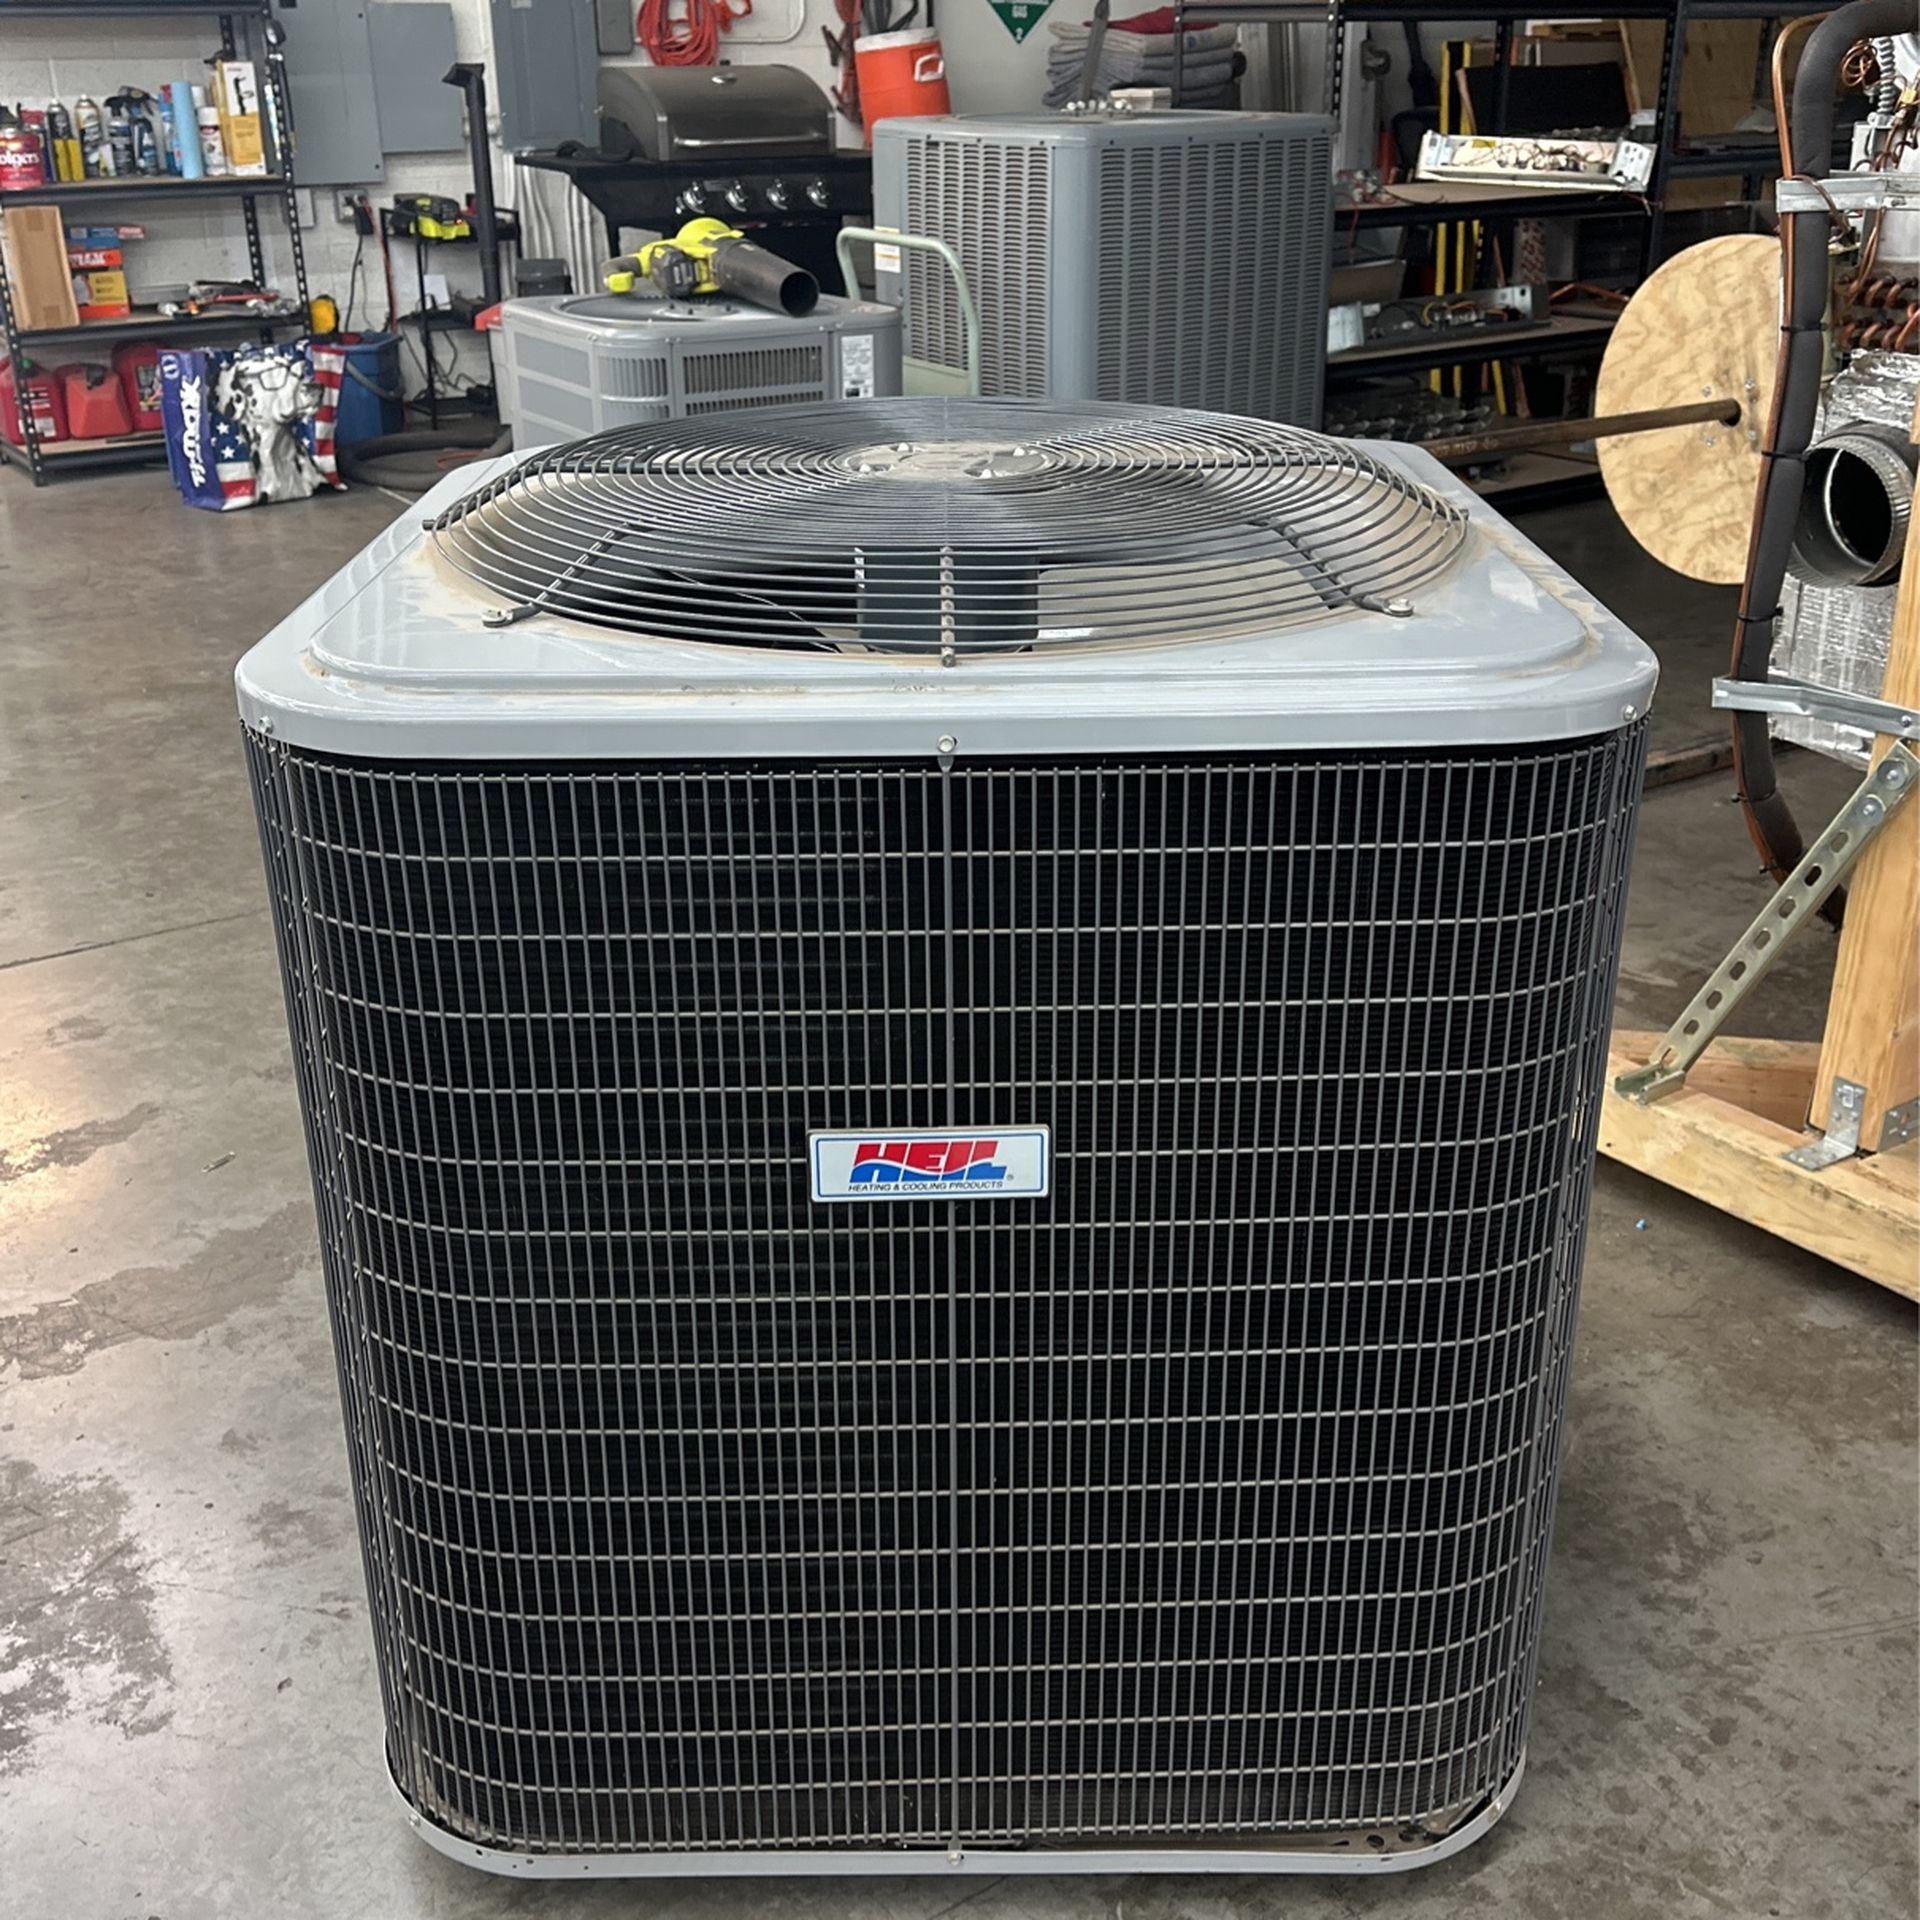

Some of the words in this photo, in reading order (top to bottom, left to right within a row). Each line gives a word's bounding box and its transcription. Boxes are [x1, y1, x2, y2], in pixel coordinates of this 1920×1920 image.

[1015, 27, 1023, 40] 2
[0, 150, 40, 168] olgers
[849, 1141, 1007, 1183] HEIL
[848, 1183, 891, 1192] HEATING
[893, 1183, 900, 1191] &
[902, 1182, 947, 1191] COOLING
[949, 1181, 1004, 1190] PRODUCTS
